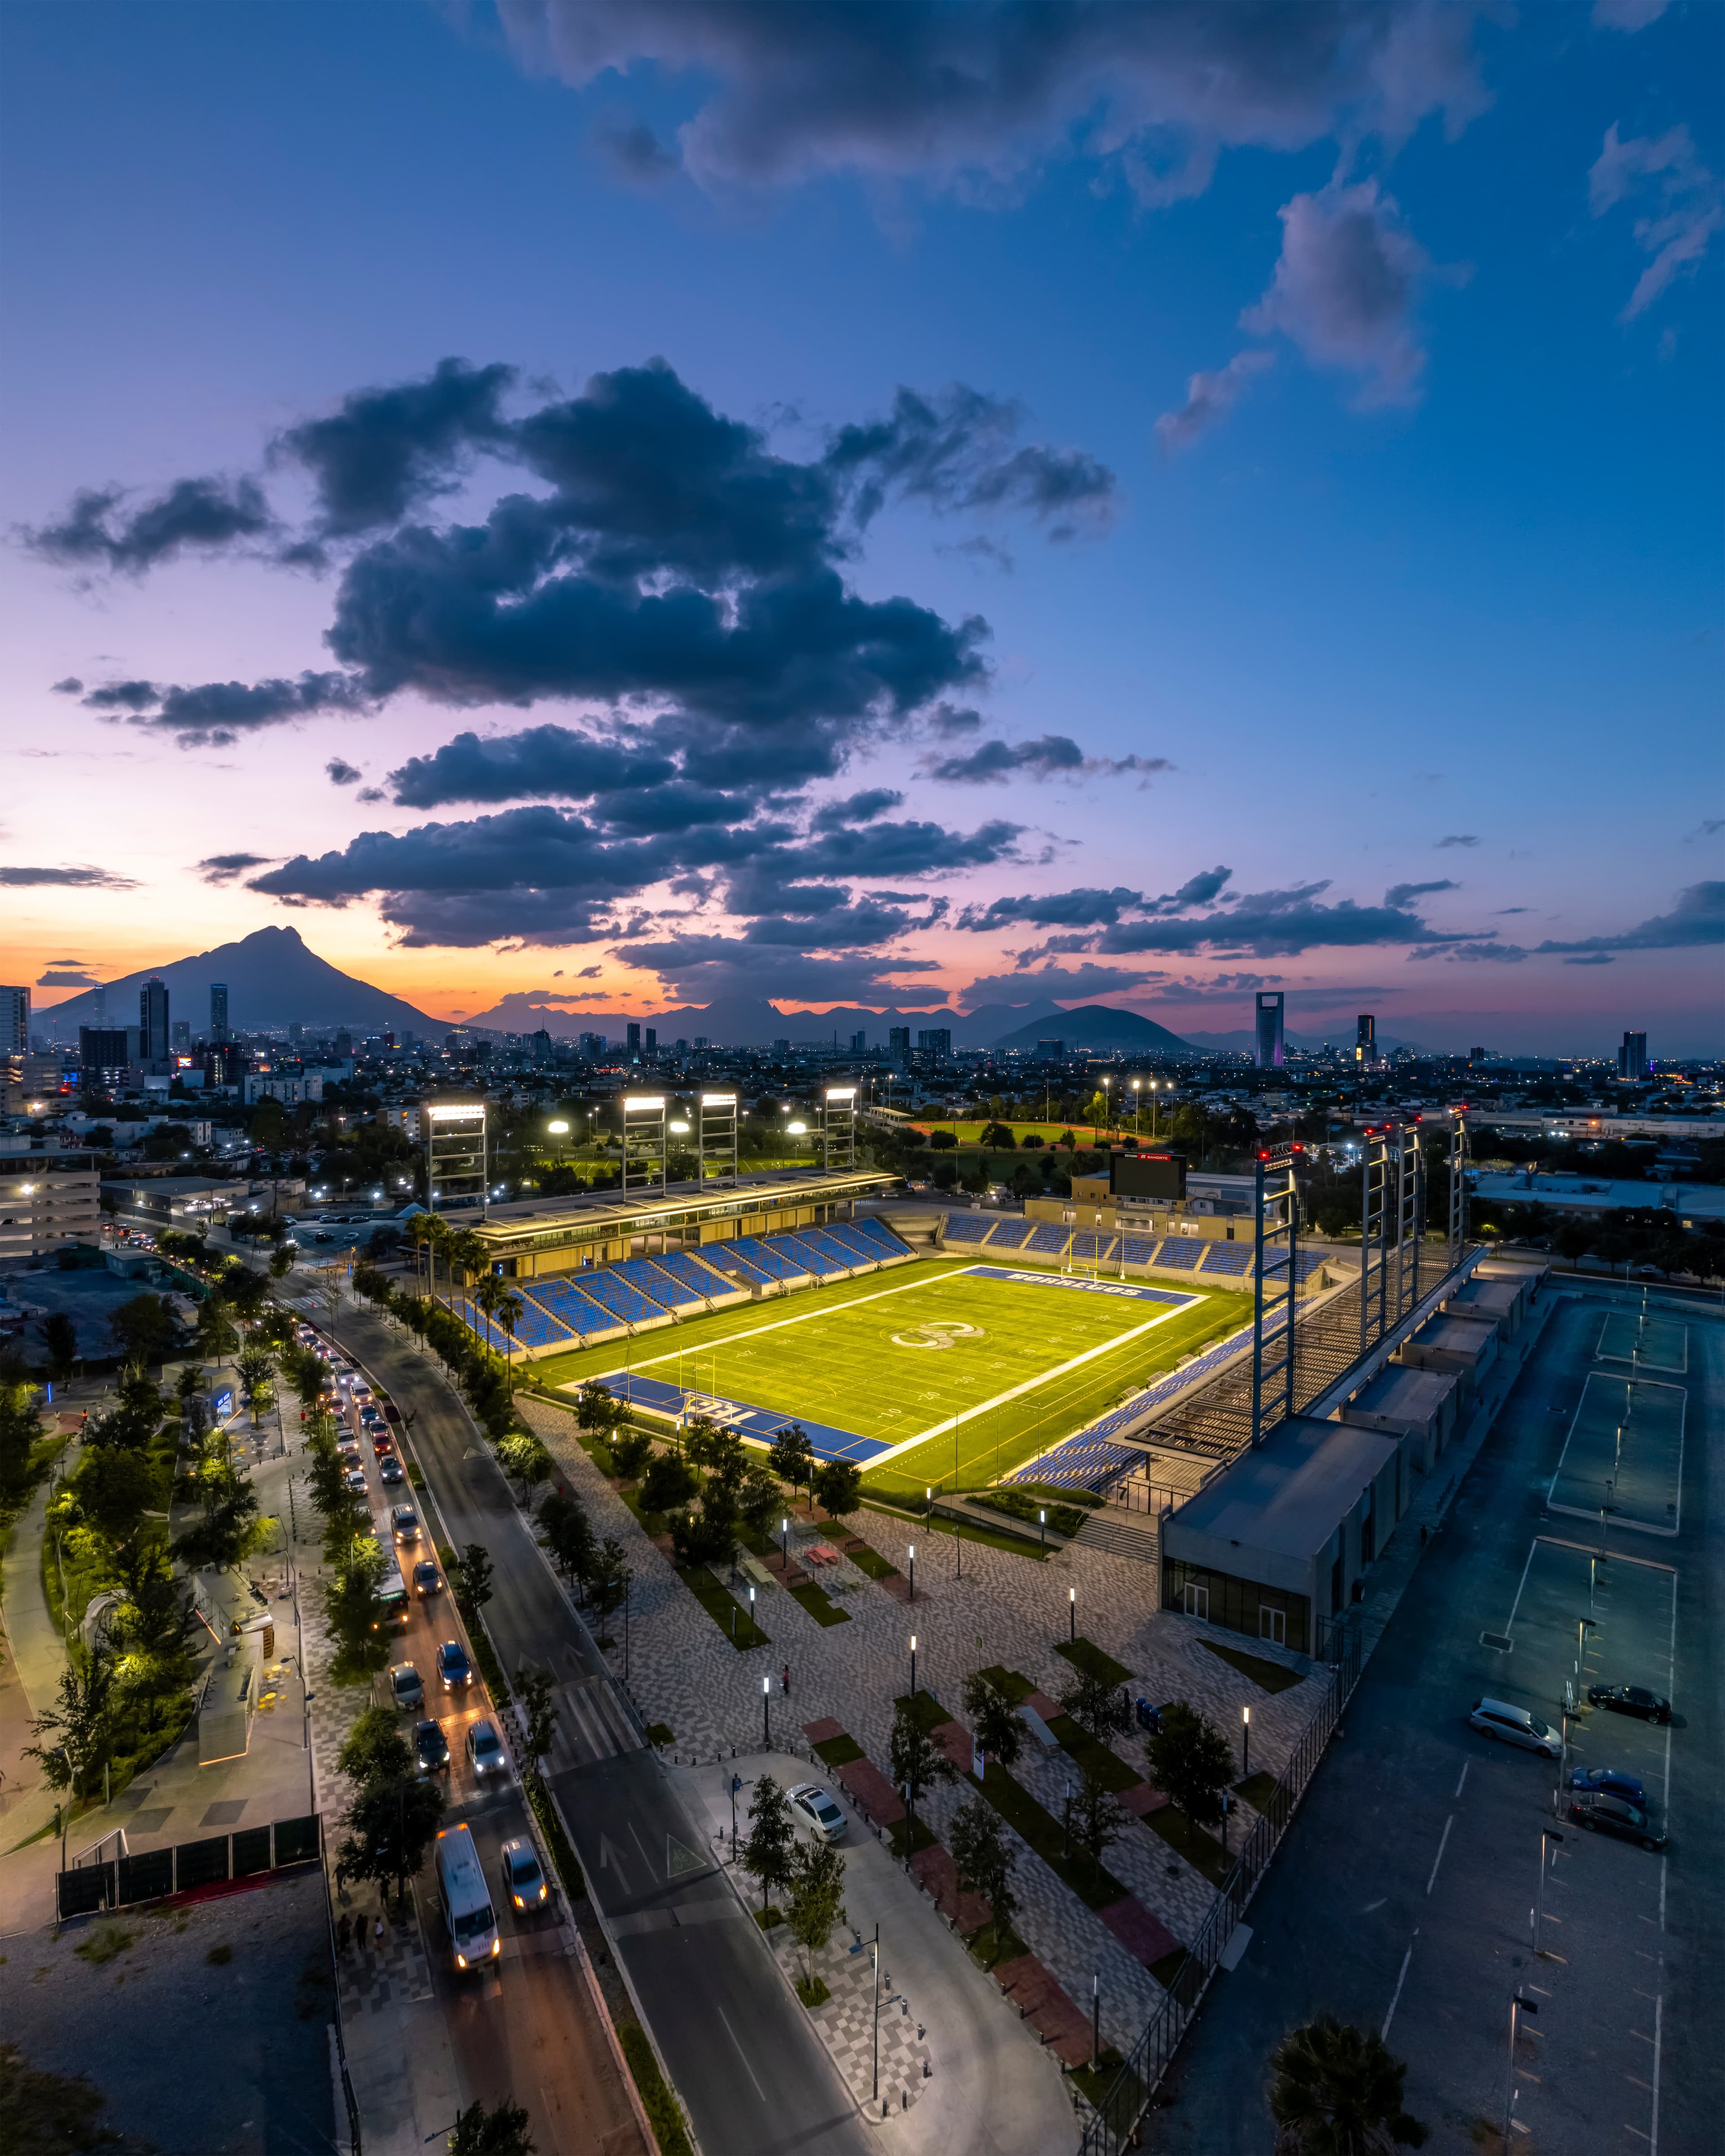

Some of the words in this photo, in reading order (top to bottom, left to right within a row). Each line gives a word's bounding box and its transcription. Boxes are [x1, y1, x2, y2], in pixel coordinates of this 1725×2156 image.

[1006, 1273, 1143, 1296] BORREGOS
[955, 1376, 975, 1384] 30
[919, 1392, 940, 1400] 20
[688, 1401, 758, 1426] TEC
[881, 1408, 902, 1417] 10
[1117, 1486, 1127, 1500] 7
